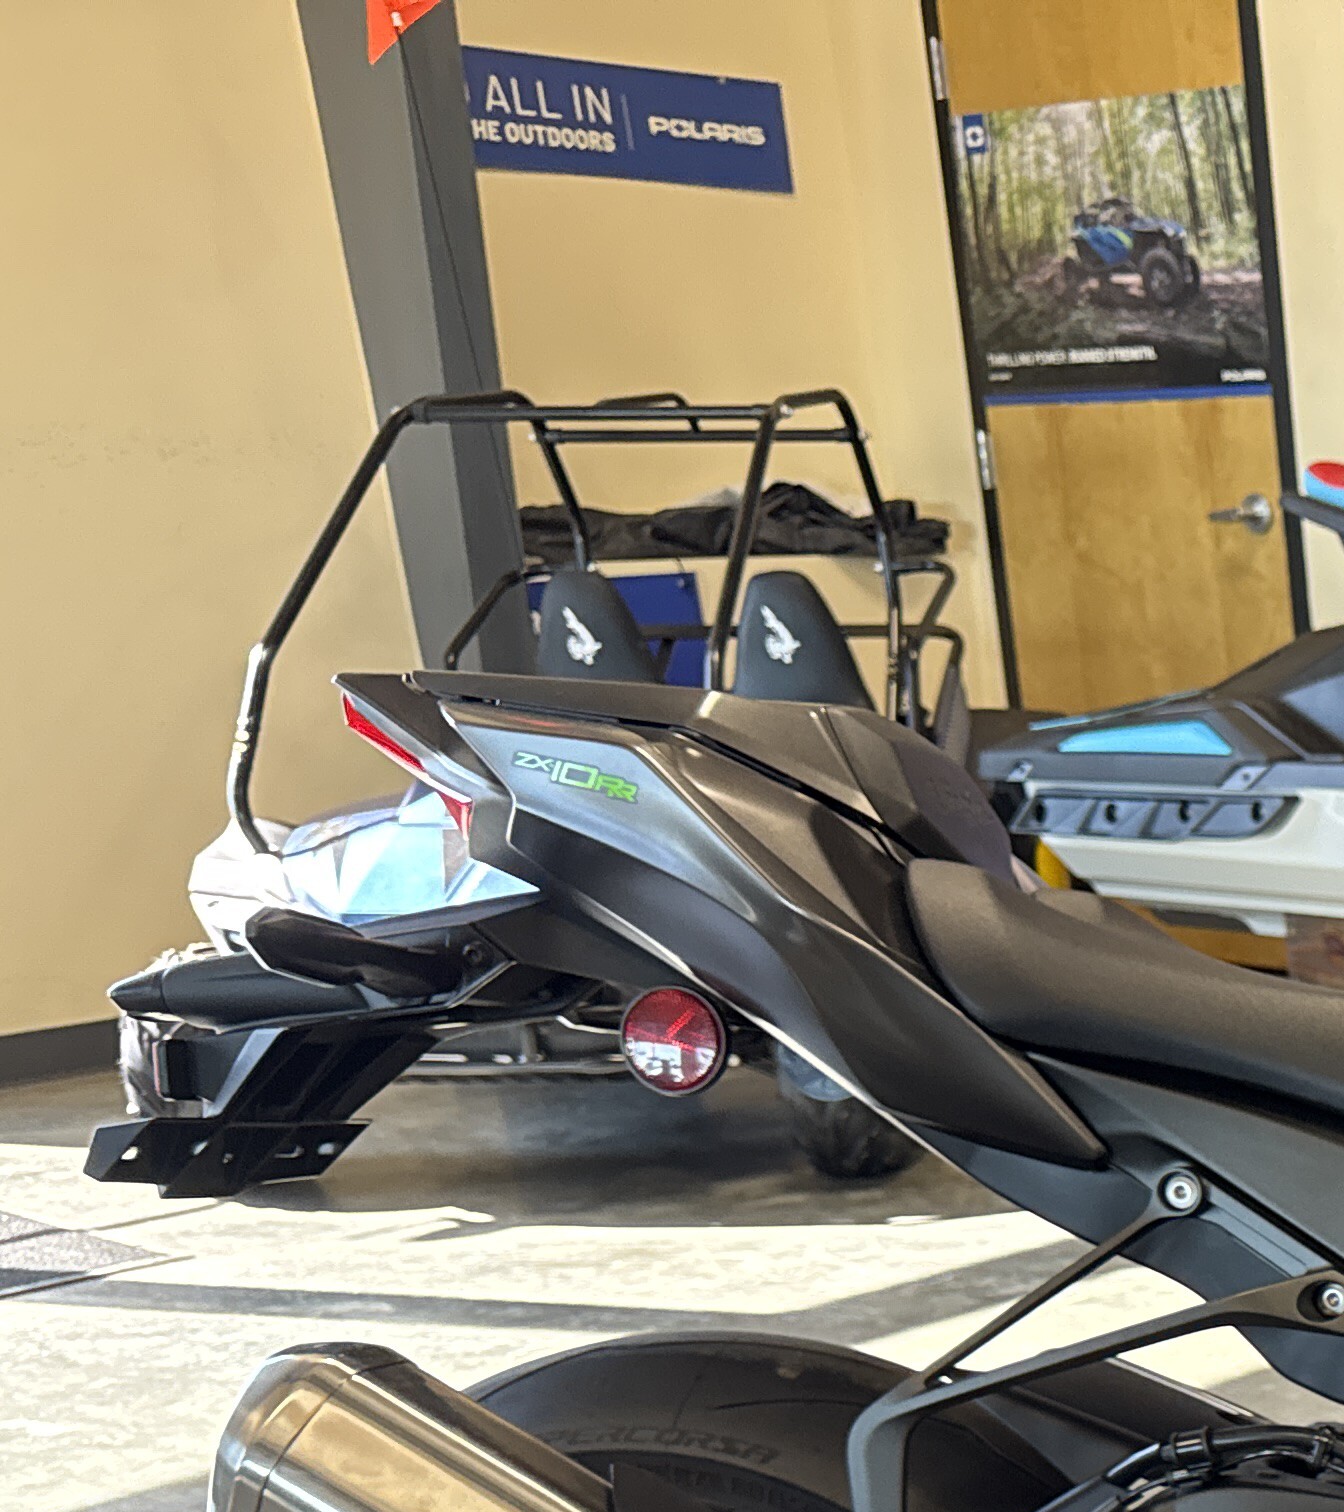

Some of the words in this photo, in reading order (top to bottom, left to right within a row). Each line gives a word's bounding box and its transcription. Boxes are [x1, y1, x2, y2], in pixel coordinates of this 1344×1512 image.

[485, 73, 563, 121] ALL
[570, 83, 614, 126] IN
[471, 118, 501, 143] HE
[504, 121, 617, 153] OUTDOORS
[647, 115, 767, 147] POLARIS
